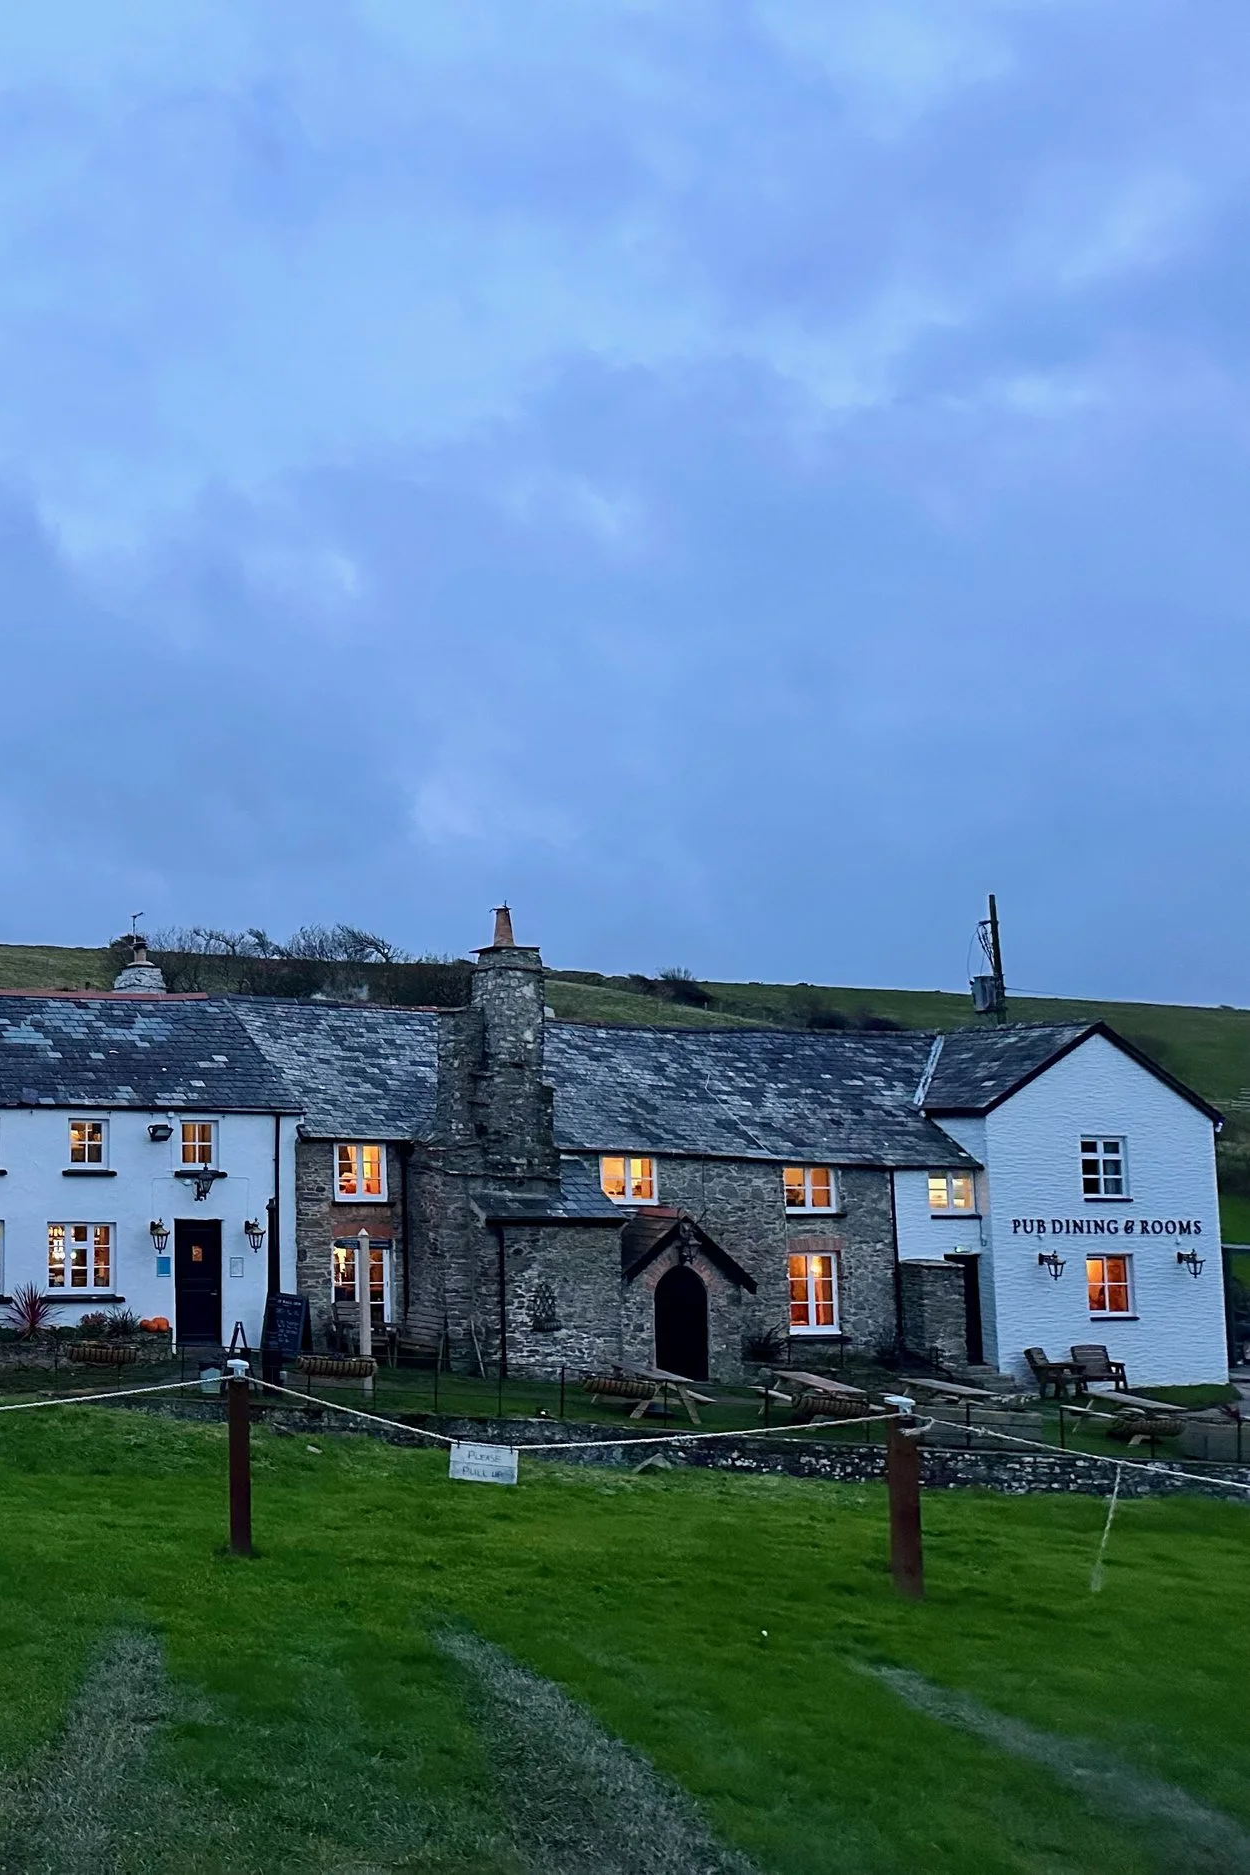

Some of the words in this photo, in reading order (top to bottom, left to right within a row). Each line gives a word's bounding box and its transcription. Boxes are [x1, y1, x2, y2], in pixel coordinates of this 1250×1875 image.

[1011, 1218, 1047, 1235] PUB
[1051, 1218, 1119, 1235] DINING
[1123, 1219, 1135, 1235] &
[1139, 1219, 1202, 1236] ROOMS
[462, 1466, 488, 1478] PULL
